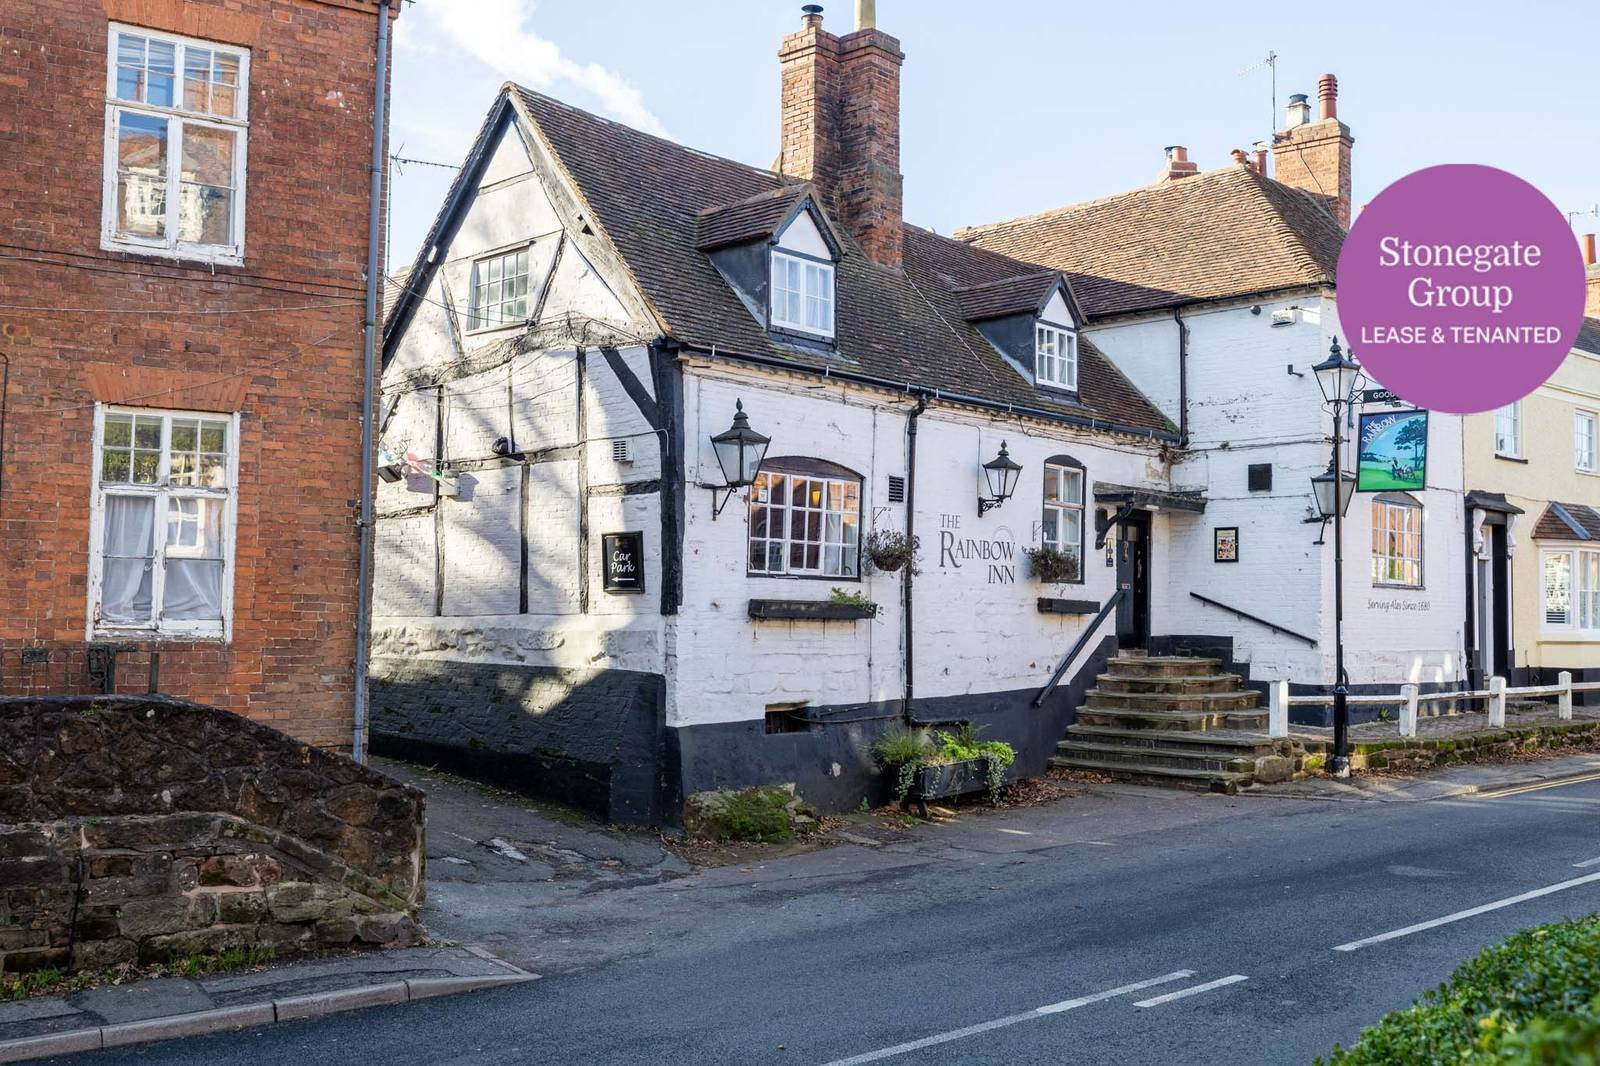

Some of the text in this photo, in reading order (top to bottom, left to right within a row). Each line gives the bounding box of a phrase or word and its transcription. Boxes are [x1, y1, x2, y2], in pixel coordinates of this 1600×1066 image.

[940, 514, 960, 529] THE
[613, 550, 632, 562] Car
[610, 560, 636, 574] Park
[988, 565, 1015, 584] INN
[1367, 600, 1390, 613] Serving
[1402, 600, 1418, 611] Since
